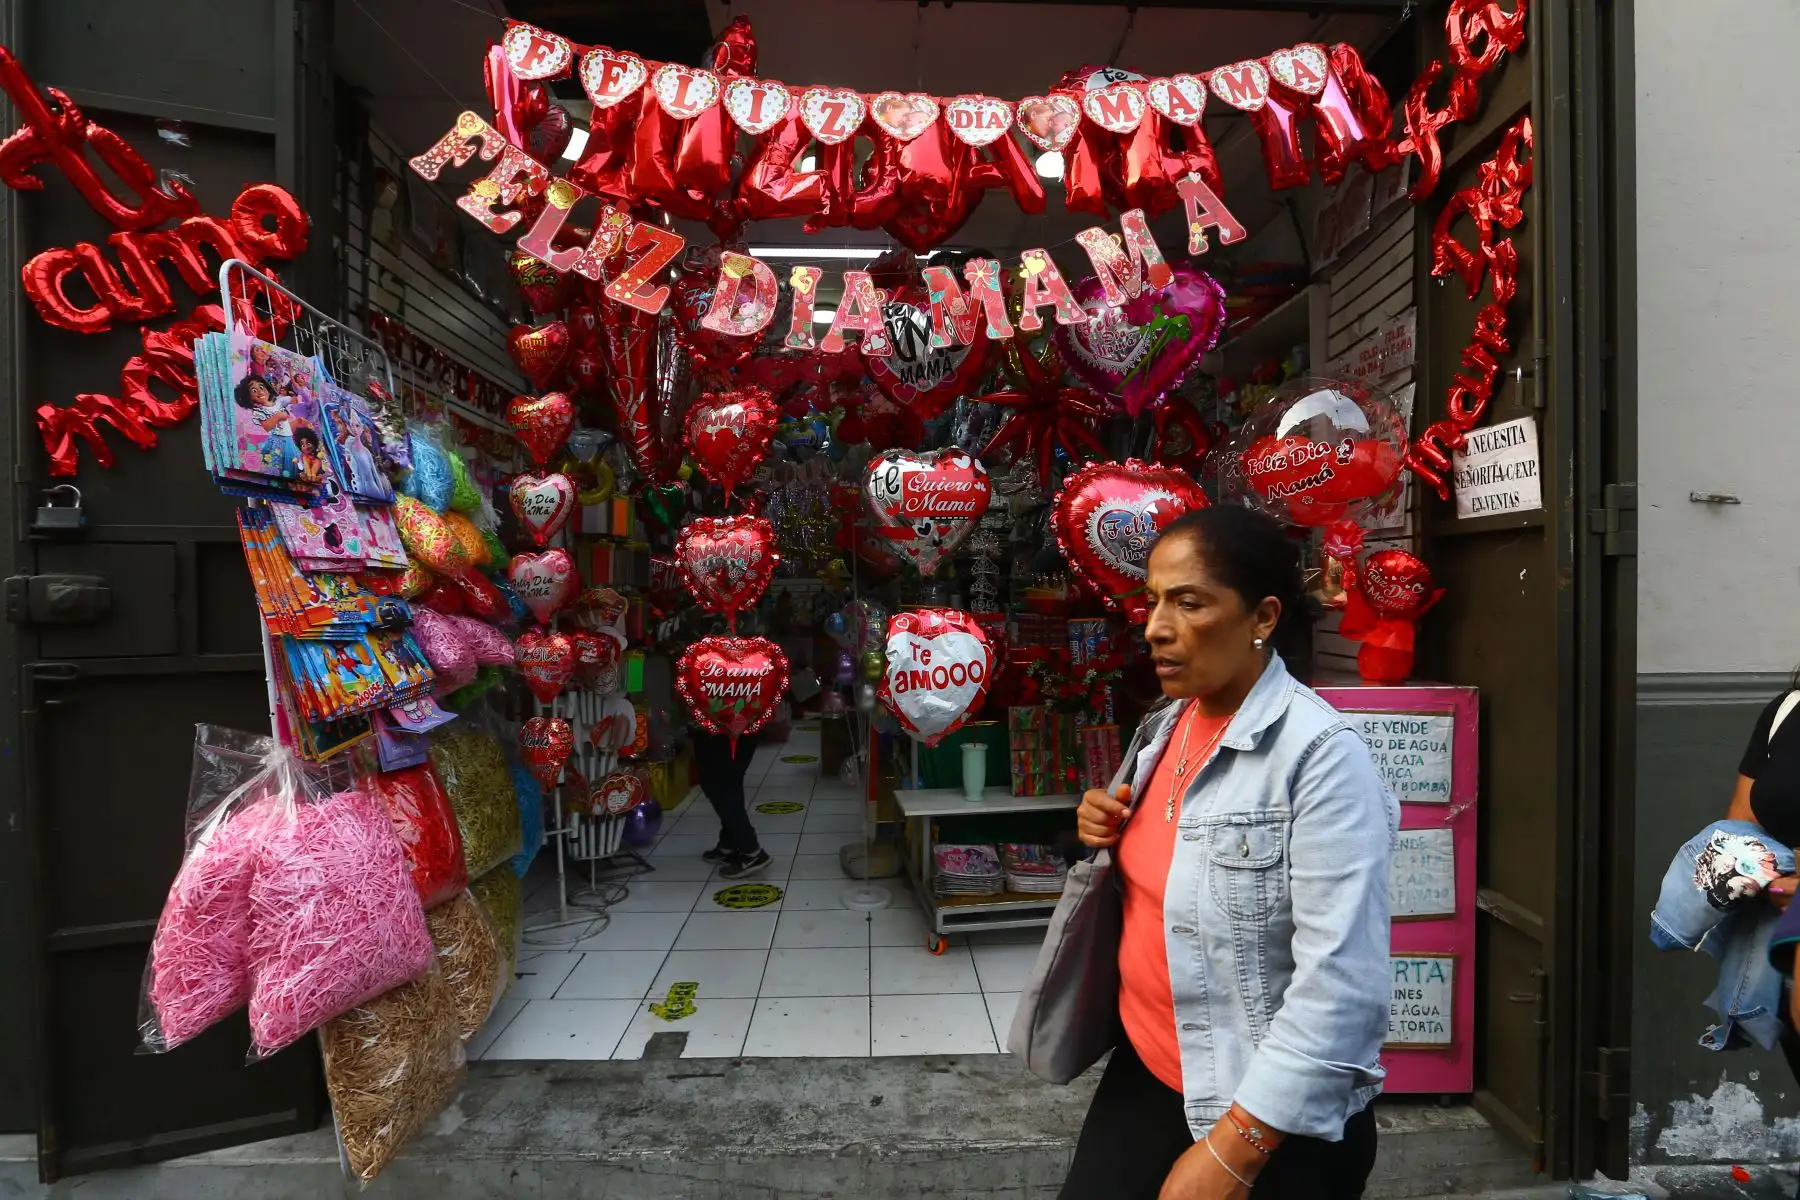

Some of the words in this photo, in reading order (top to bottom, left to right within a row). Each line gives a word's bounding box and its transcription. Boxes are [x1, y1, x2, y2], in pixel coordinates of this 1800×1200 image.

[1097, 68, 1128, 82] te
[408, 110, 685, 315] FELIZ
[701, 250, 894, 358] DIA
[921, 171, 1247, 350] MAMA
[1076, 308, 1129, 338] Feliz
[1473, 423, 1528, 456] NECESITA
[871, 465, 901, 501] te
[907, 472, 973, 493] Quiero
[1267, 461, 1336, 501] Mamá
[1455, 464, 1505, 490] SEÑORITA
[905, 491, 977, 512] Mamá
[1484, 491, 1521, 511] VENTAS
[1101, 514, 1158, 540] Feliz
[1367, 568, 1388, 588] Feliz
[909, 640, 932, 666] Te
[700, 660, 724, 677] Te
[726, 666, 770, 677] amo
[358, 681, 383, 706] MOUSE
[707, 676, 761, 697] MAMÁ
[1363, 721, 1379, 734] SE
[1382, 721, 1429, 735] VENDE
[1388, 739, 1406, 750] DE
[1409, 739, 1448, 753] AGUA
[1371, 753, 1388, 766] OR
[1393, 754, 1425, 766] CAJA
[1380, 766, 1413, 779] ARCA
[1393, 836, 1427, 852] ENDE
[1395, 960, 1445, 984] RTA
[1394, 988, 1423, 1000] INES
[1401, 1003, 1440, 1017] AGUA
[1400, 1020, 1444, 1033] TORTA
